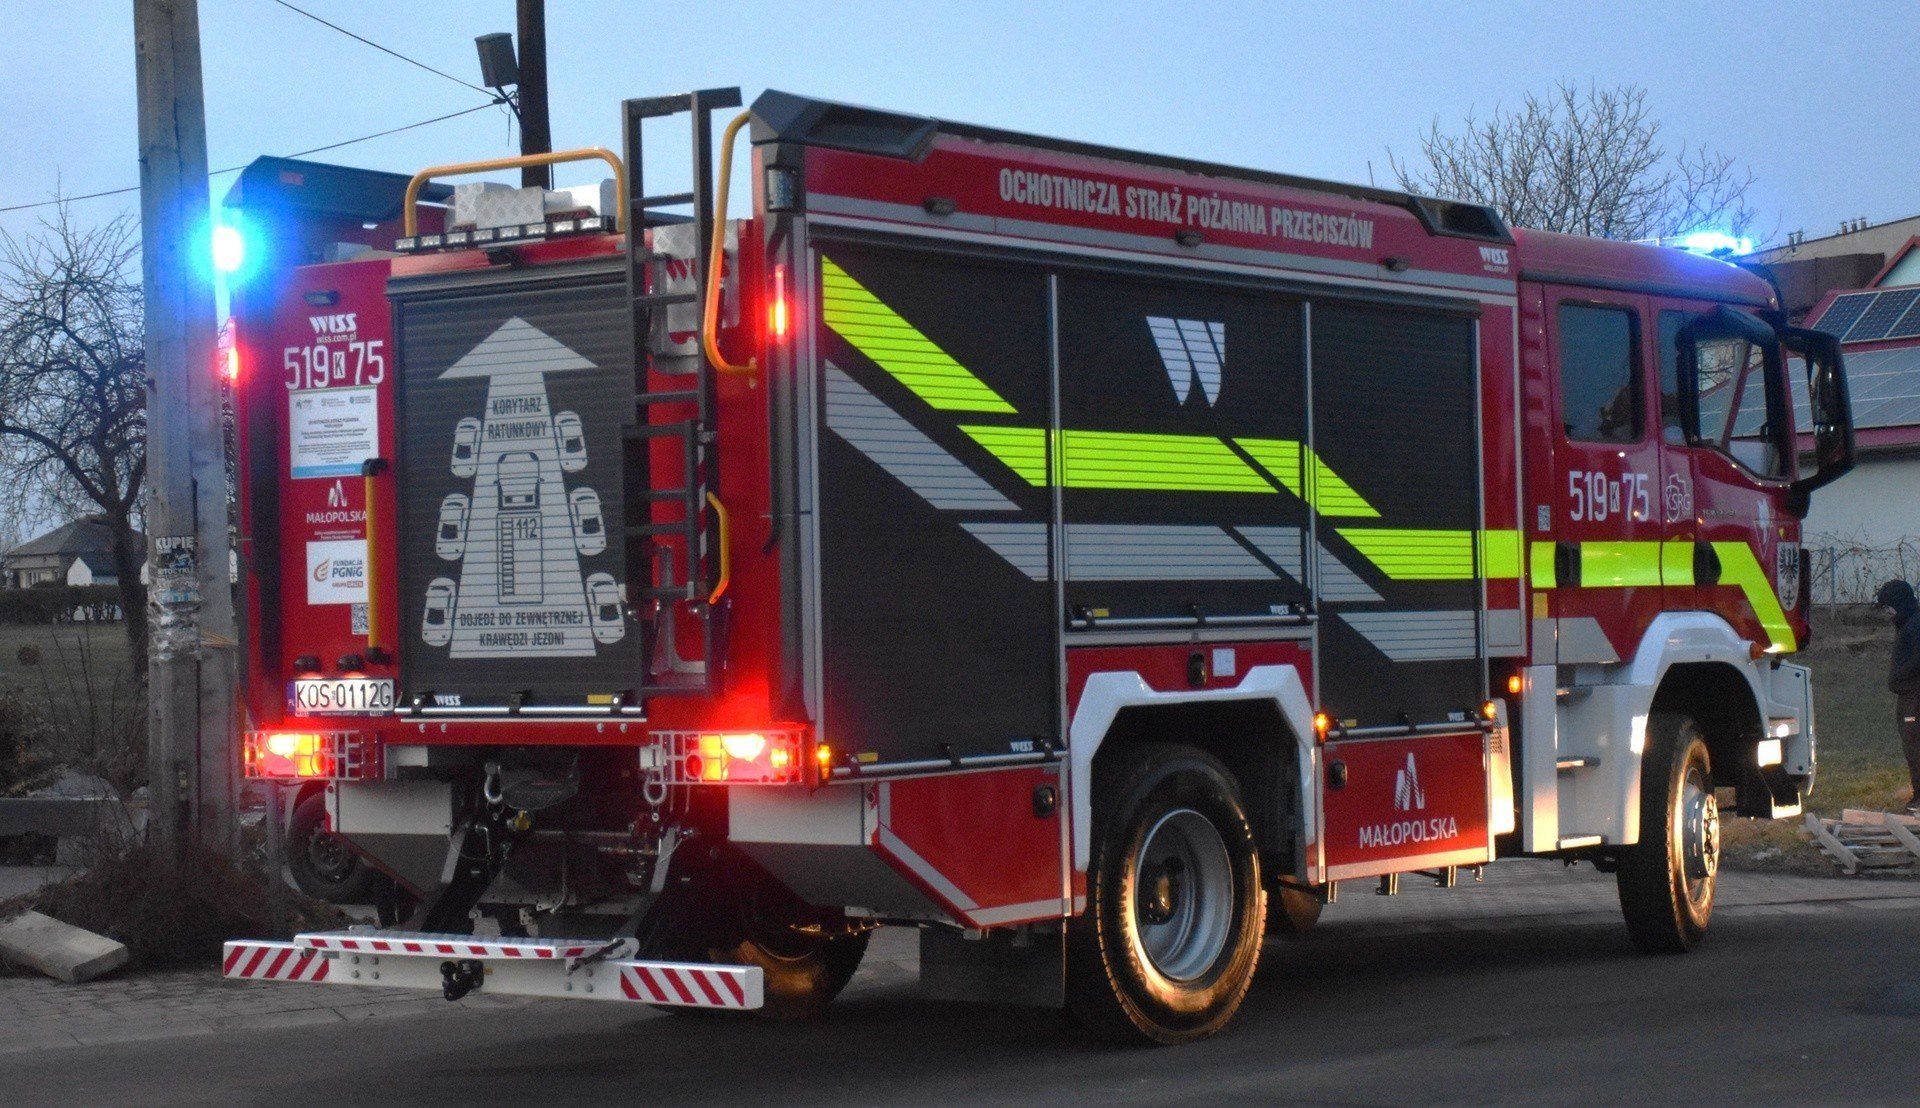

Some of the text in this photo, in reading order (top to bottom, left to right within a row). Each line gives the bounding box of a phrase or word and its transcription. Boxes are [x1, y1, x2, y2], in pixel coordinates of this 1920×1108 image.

[999, 167, 1375, 250] OCHOTNICZA STRAŻ POŻARNA PRZECISZÓW
[1479, 246, 1509, 265] WISS
[309, 313, 357, 334] WISS
[316, 332, 357, 343] wiss.com.pl
[284, 340, 385, 390] 519 K 75
[492, 397, 542, 415] KORYTARZ
[488, 421, 547, 439] RATUNKOWY
[1569, 471, 1607, 522] 519
[1622, 472, 1650, 522] 75
[306, 510, 367, 524] MAŁOPOLSKA
[516, 518, 538, 539] 112
[332, 566, 363, 578] PGNiG
[499, 612, 512, 626] DO
[515, 610, 584, 628] ZEWNĘTRZNEJ
[480, 632, 565, 649] KRAWĘDZI JEZDNI
[296, 682, 391, 708] KOS 0112G
[433, 695, 461, 706] WISS
[1359, 816, 1459, 850] MAŁOPOLSKA
